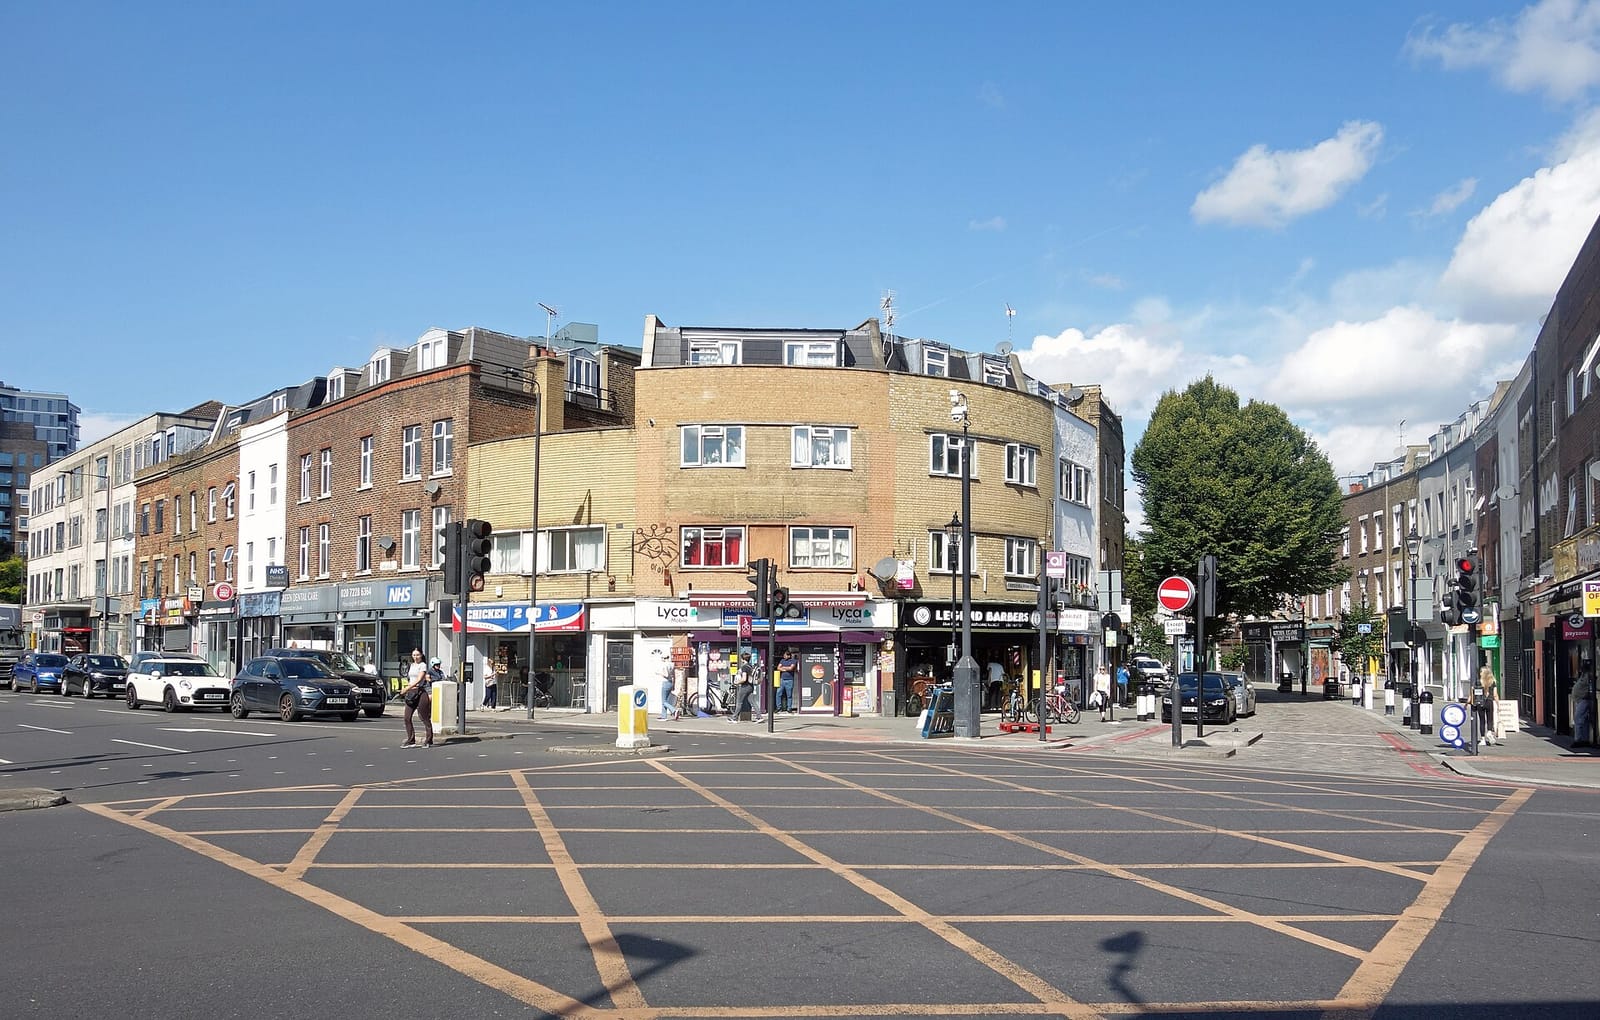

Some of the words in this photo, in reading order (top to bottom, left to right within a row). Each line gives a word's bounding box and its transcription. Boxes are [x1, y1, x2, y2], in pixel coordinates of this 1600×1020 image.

[388, 586, 411, 603] NHS
[466, 608, 507, 619] CHICKEN
[513, 608, 522, 618] 2
[657, 606, 688, 619] Lyca
[832, 607, 862, 620] Lyca
[985, 611, 1029, 622] BARBERS
